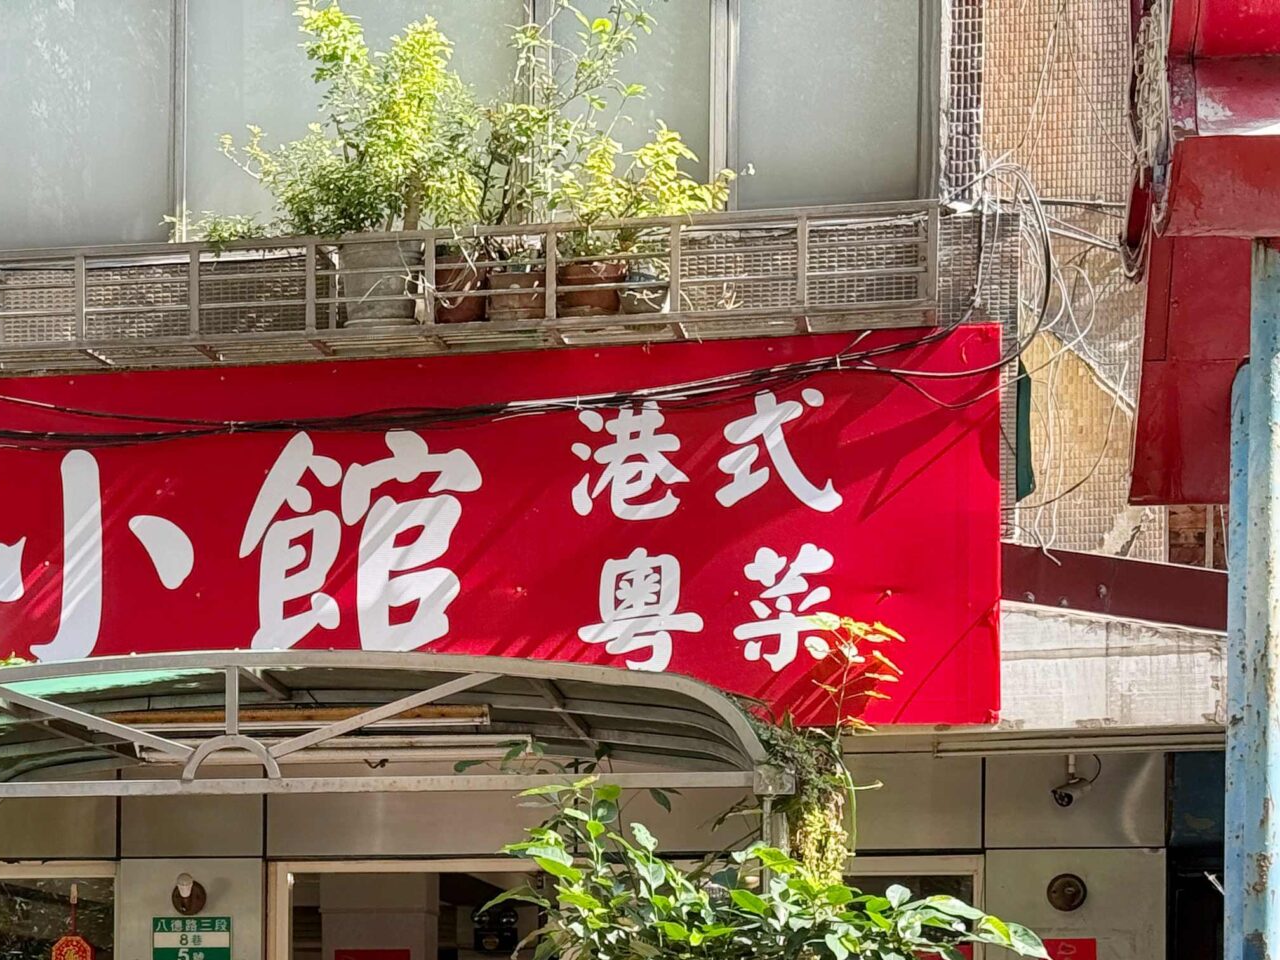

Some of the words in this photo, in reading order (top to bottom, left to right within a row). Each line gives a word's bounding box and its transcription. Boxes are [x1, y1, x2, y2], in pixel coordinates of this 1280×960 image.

[571, 388, 843, 520] 港式
[155, 919, 228, 932] 八德路三段
[179, 934, 202, 946] 8巷
